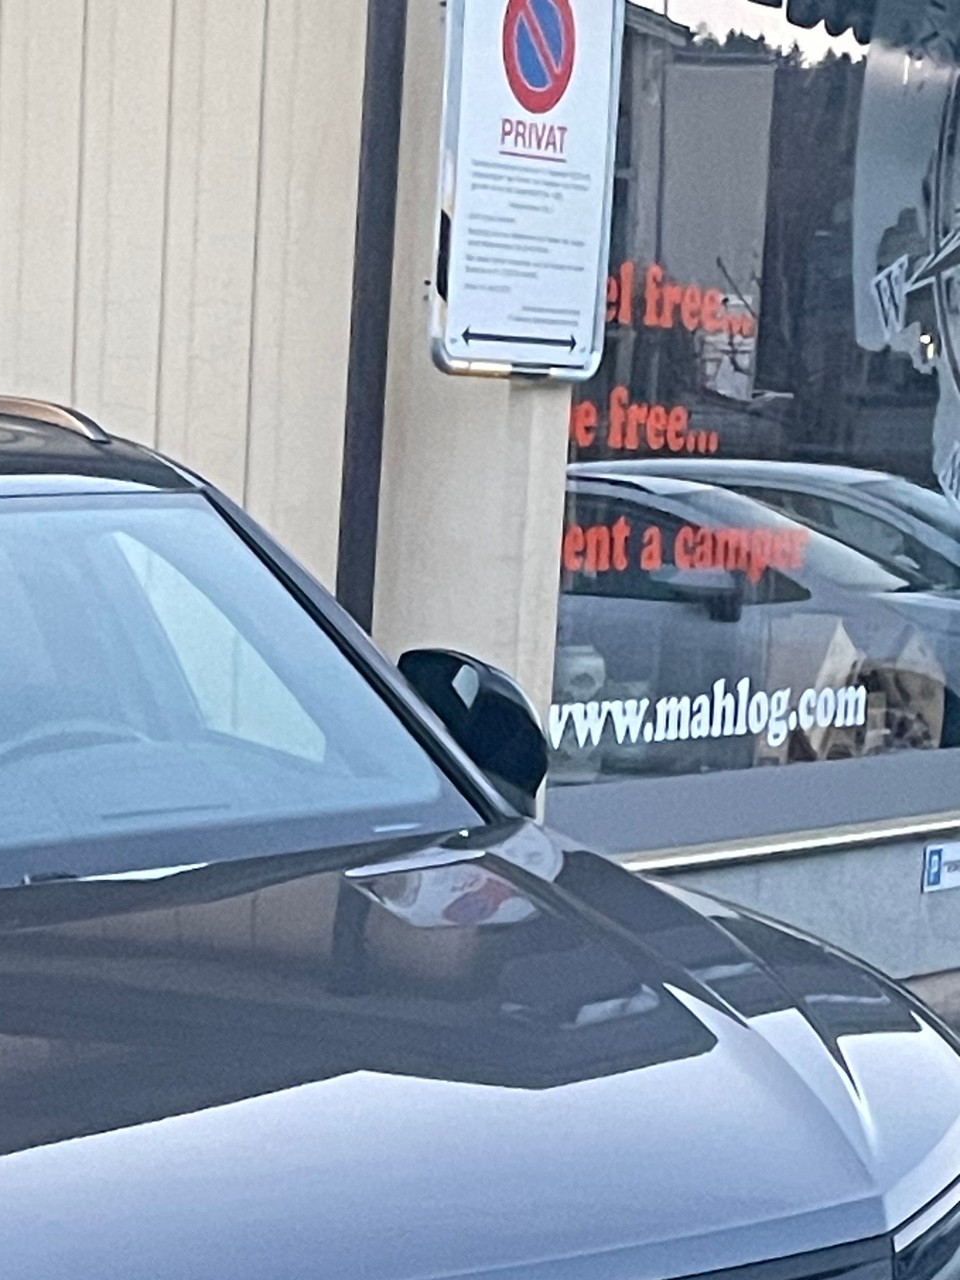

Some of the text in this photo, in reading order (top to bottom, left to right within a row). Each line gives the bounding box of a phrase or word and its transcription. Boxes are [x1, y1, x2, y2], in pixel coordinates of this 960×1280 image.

[501, 118, 568, 154] PRIVAT
[607, 385, 718, 453] free...
[640, 525, 661, 571] a
[674, 524, 809, 584] camper
